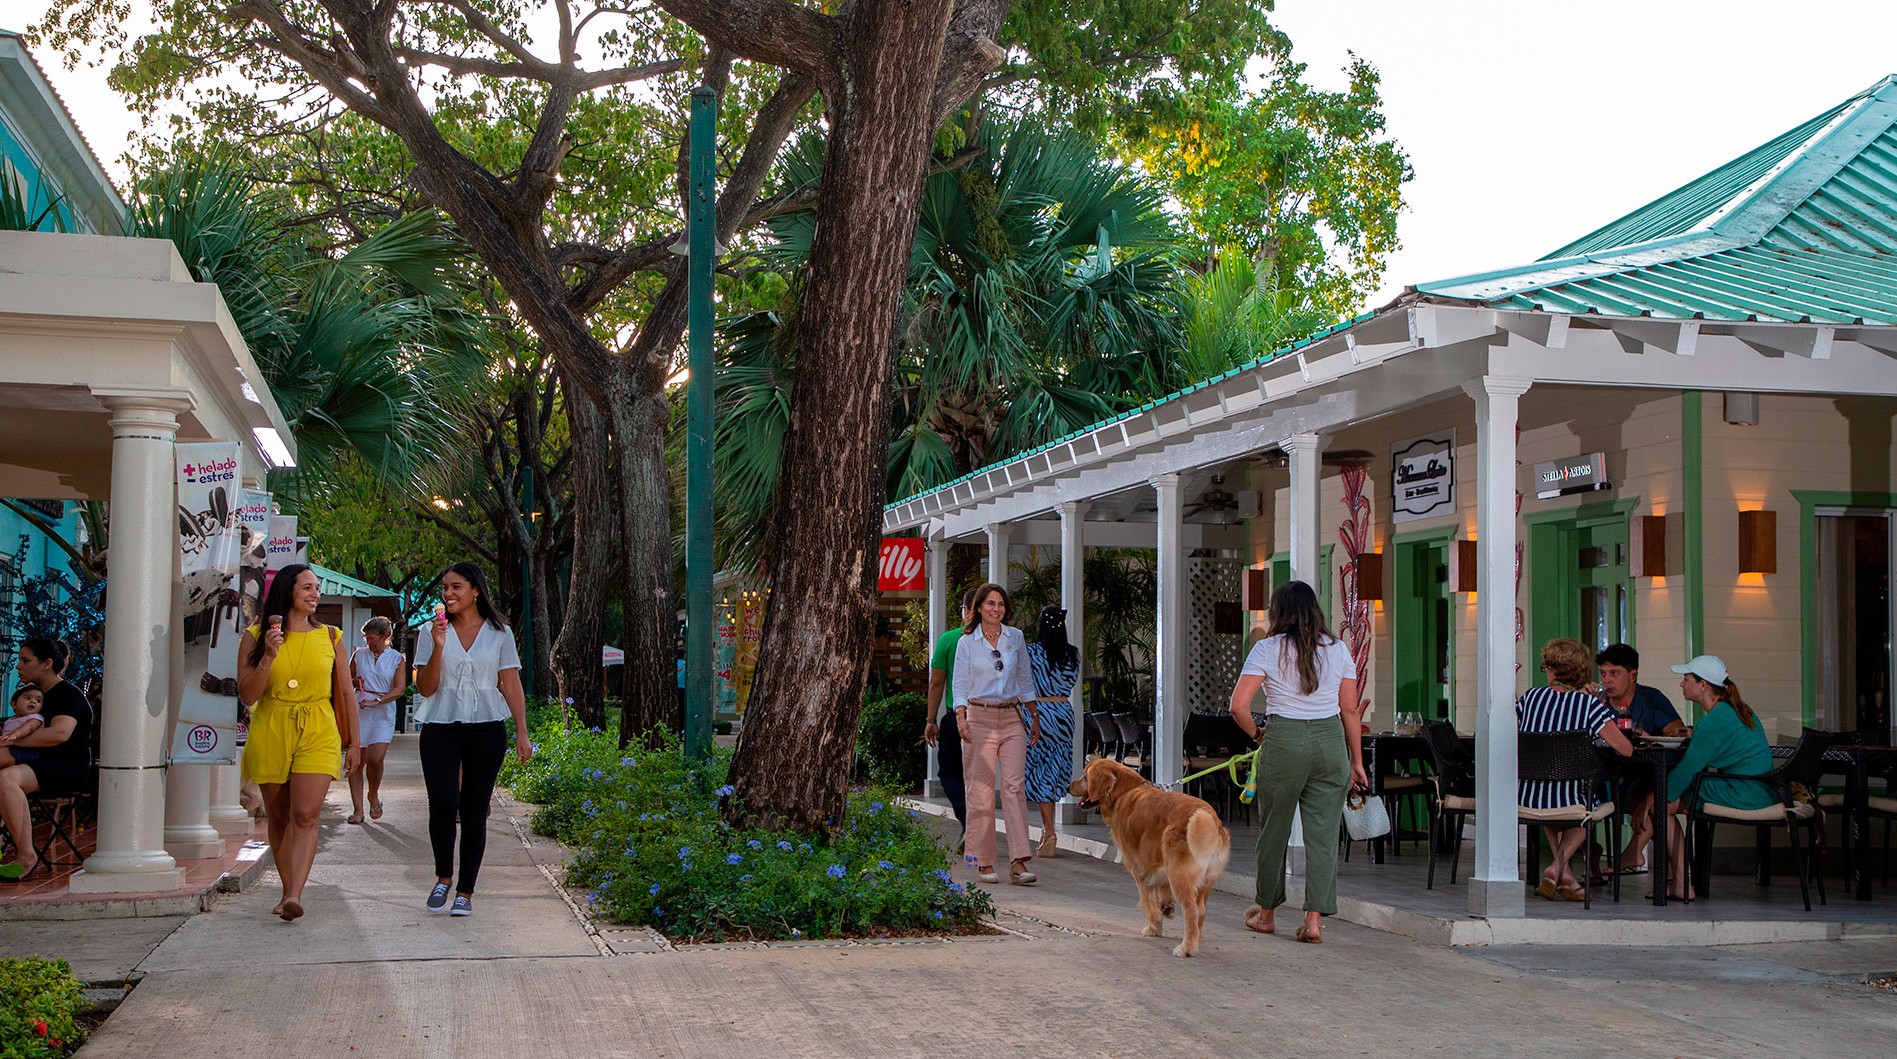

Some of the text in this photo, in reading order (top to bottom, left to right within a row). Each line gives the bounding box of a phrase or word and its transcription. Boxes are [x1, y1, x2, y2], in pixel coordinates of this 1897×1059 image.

[198, 457, 237, 475] helado
[199, 470, 234, 484] estrés
[1543, 464, 1592, 482] STELLA ARTOIS
[240, 503, 267, 513] elado
[240, 513, 264, 522] strés
[269, 536, 293, 546] elado
[268, 545, 291, 554] strés
[879, 544, 922, 587] illy
[745, 606, 759, 614] we
[194, 730, 212, 741] BR
